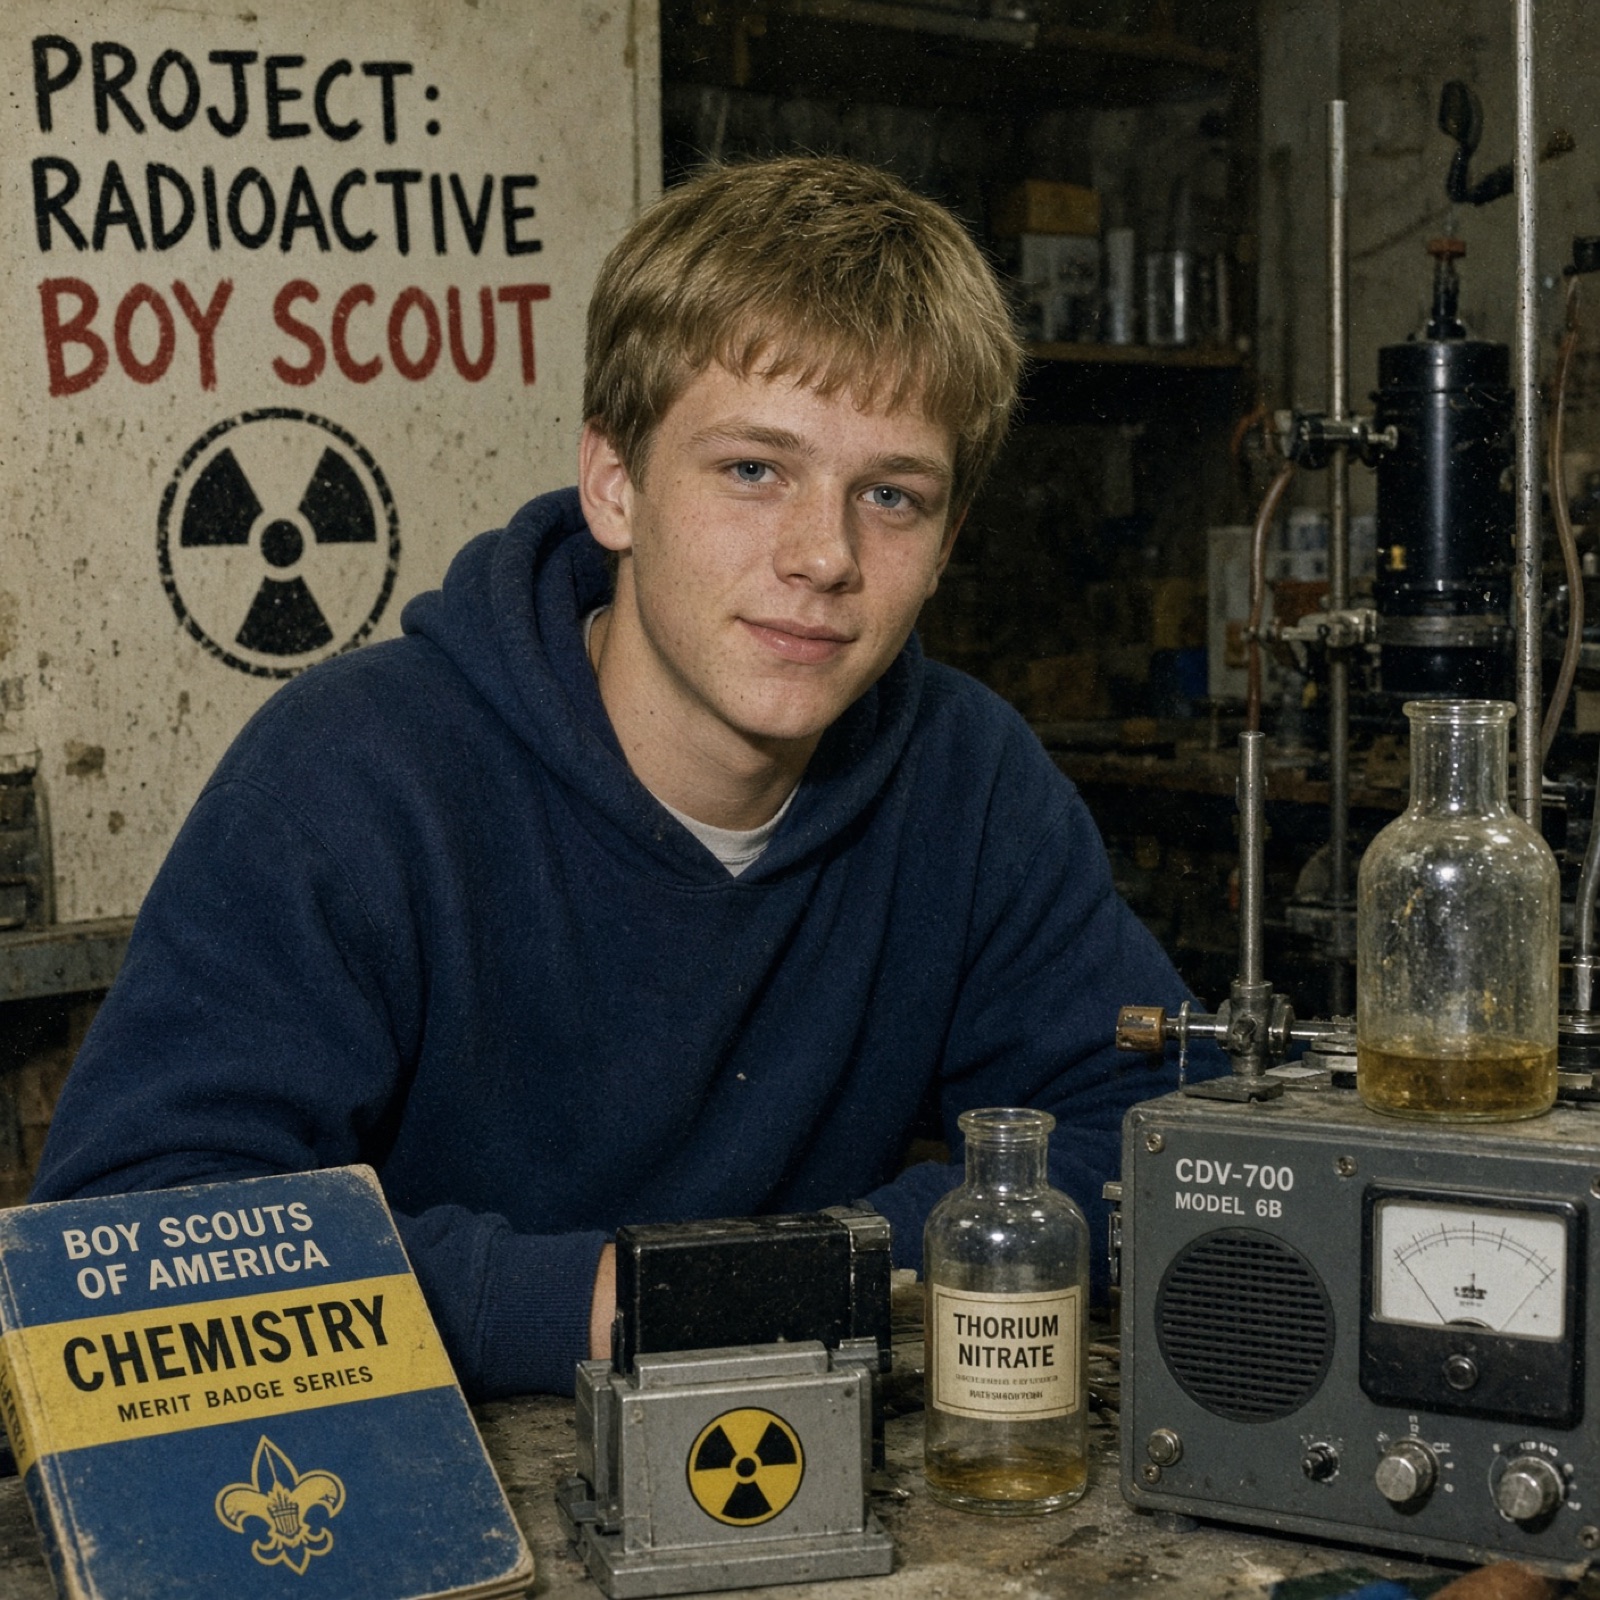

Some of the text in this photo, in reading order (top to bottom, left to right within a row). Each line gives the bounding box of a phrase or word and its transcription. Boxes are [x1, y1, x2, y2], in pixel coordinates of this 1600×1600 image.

[31, 35, 440, 144] PROJECT:
[31, 157, 543, 256] RADIOACTIVE
[39, 278, 551, 397] BOY SCOUT
[1175, 1158, 1295, 1192] CDV-700
[62, 1202, 314, 1260] BOY SCOUTS
[1174, 1192, 1283, 1219] MODEL 6B
[76, 1239, 330, 1299] OF AMERICA
[62, 1295, 390, 1392] CHEMISTRY
[953, 1312, 1059, 1340] THORIUM
[958, 1343, 1055, 1369] NITRATE
[117, 1366, 374, 1423] MERIT BADGE SERIES
